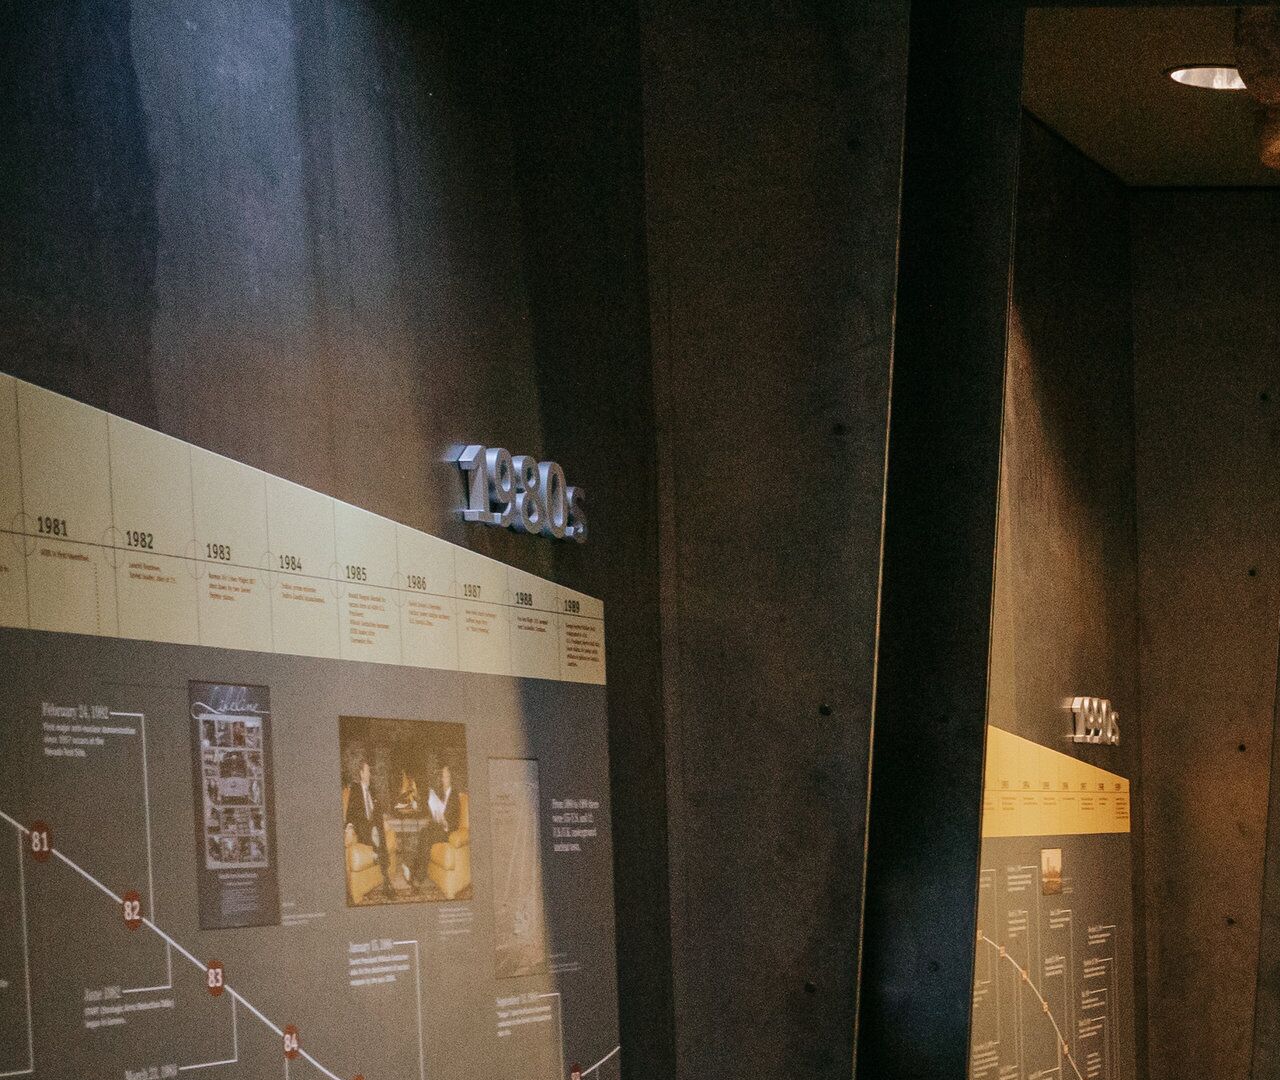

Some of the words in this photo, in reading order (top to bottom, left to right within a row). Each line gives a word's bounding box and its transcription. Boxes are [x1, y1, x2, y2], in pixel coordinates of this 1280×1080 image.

[458, 445, 588, 543] 1980s
[37, 516, 68, 537] 1981
[126, 531, 154, 549] 1982
[206, 543, 231, 561] 1983
[279, 555, 302, 571] 1984
[345, 565, 367, 581] 1985
[407, 575, 427, 590] 1986
[463, 583, 481, 598] 1987
[516, 592, 533, 606] 1988
[564, 599, 580, 613] 1989
[31, 832, 49, 852] 81
[123, 901, 140, 920] 82
[207, 968, 222, 988] 83
[283, 1033, 298, 1052] 84
